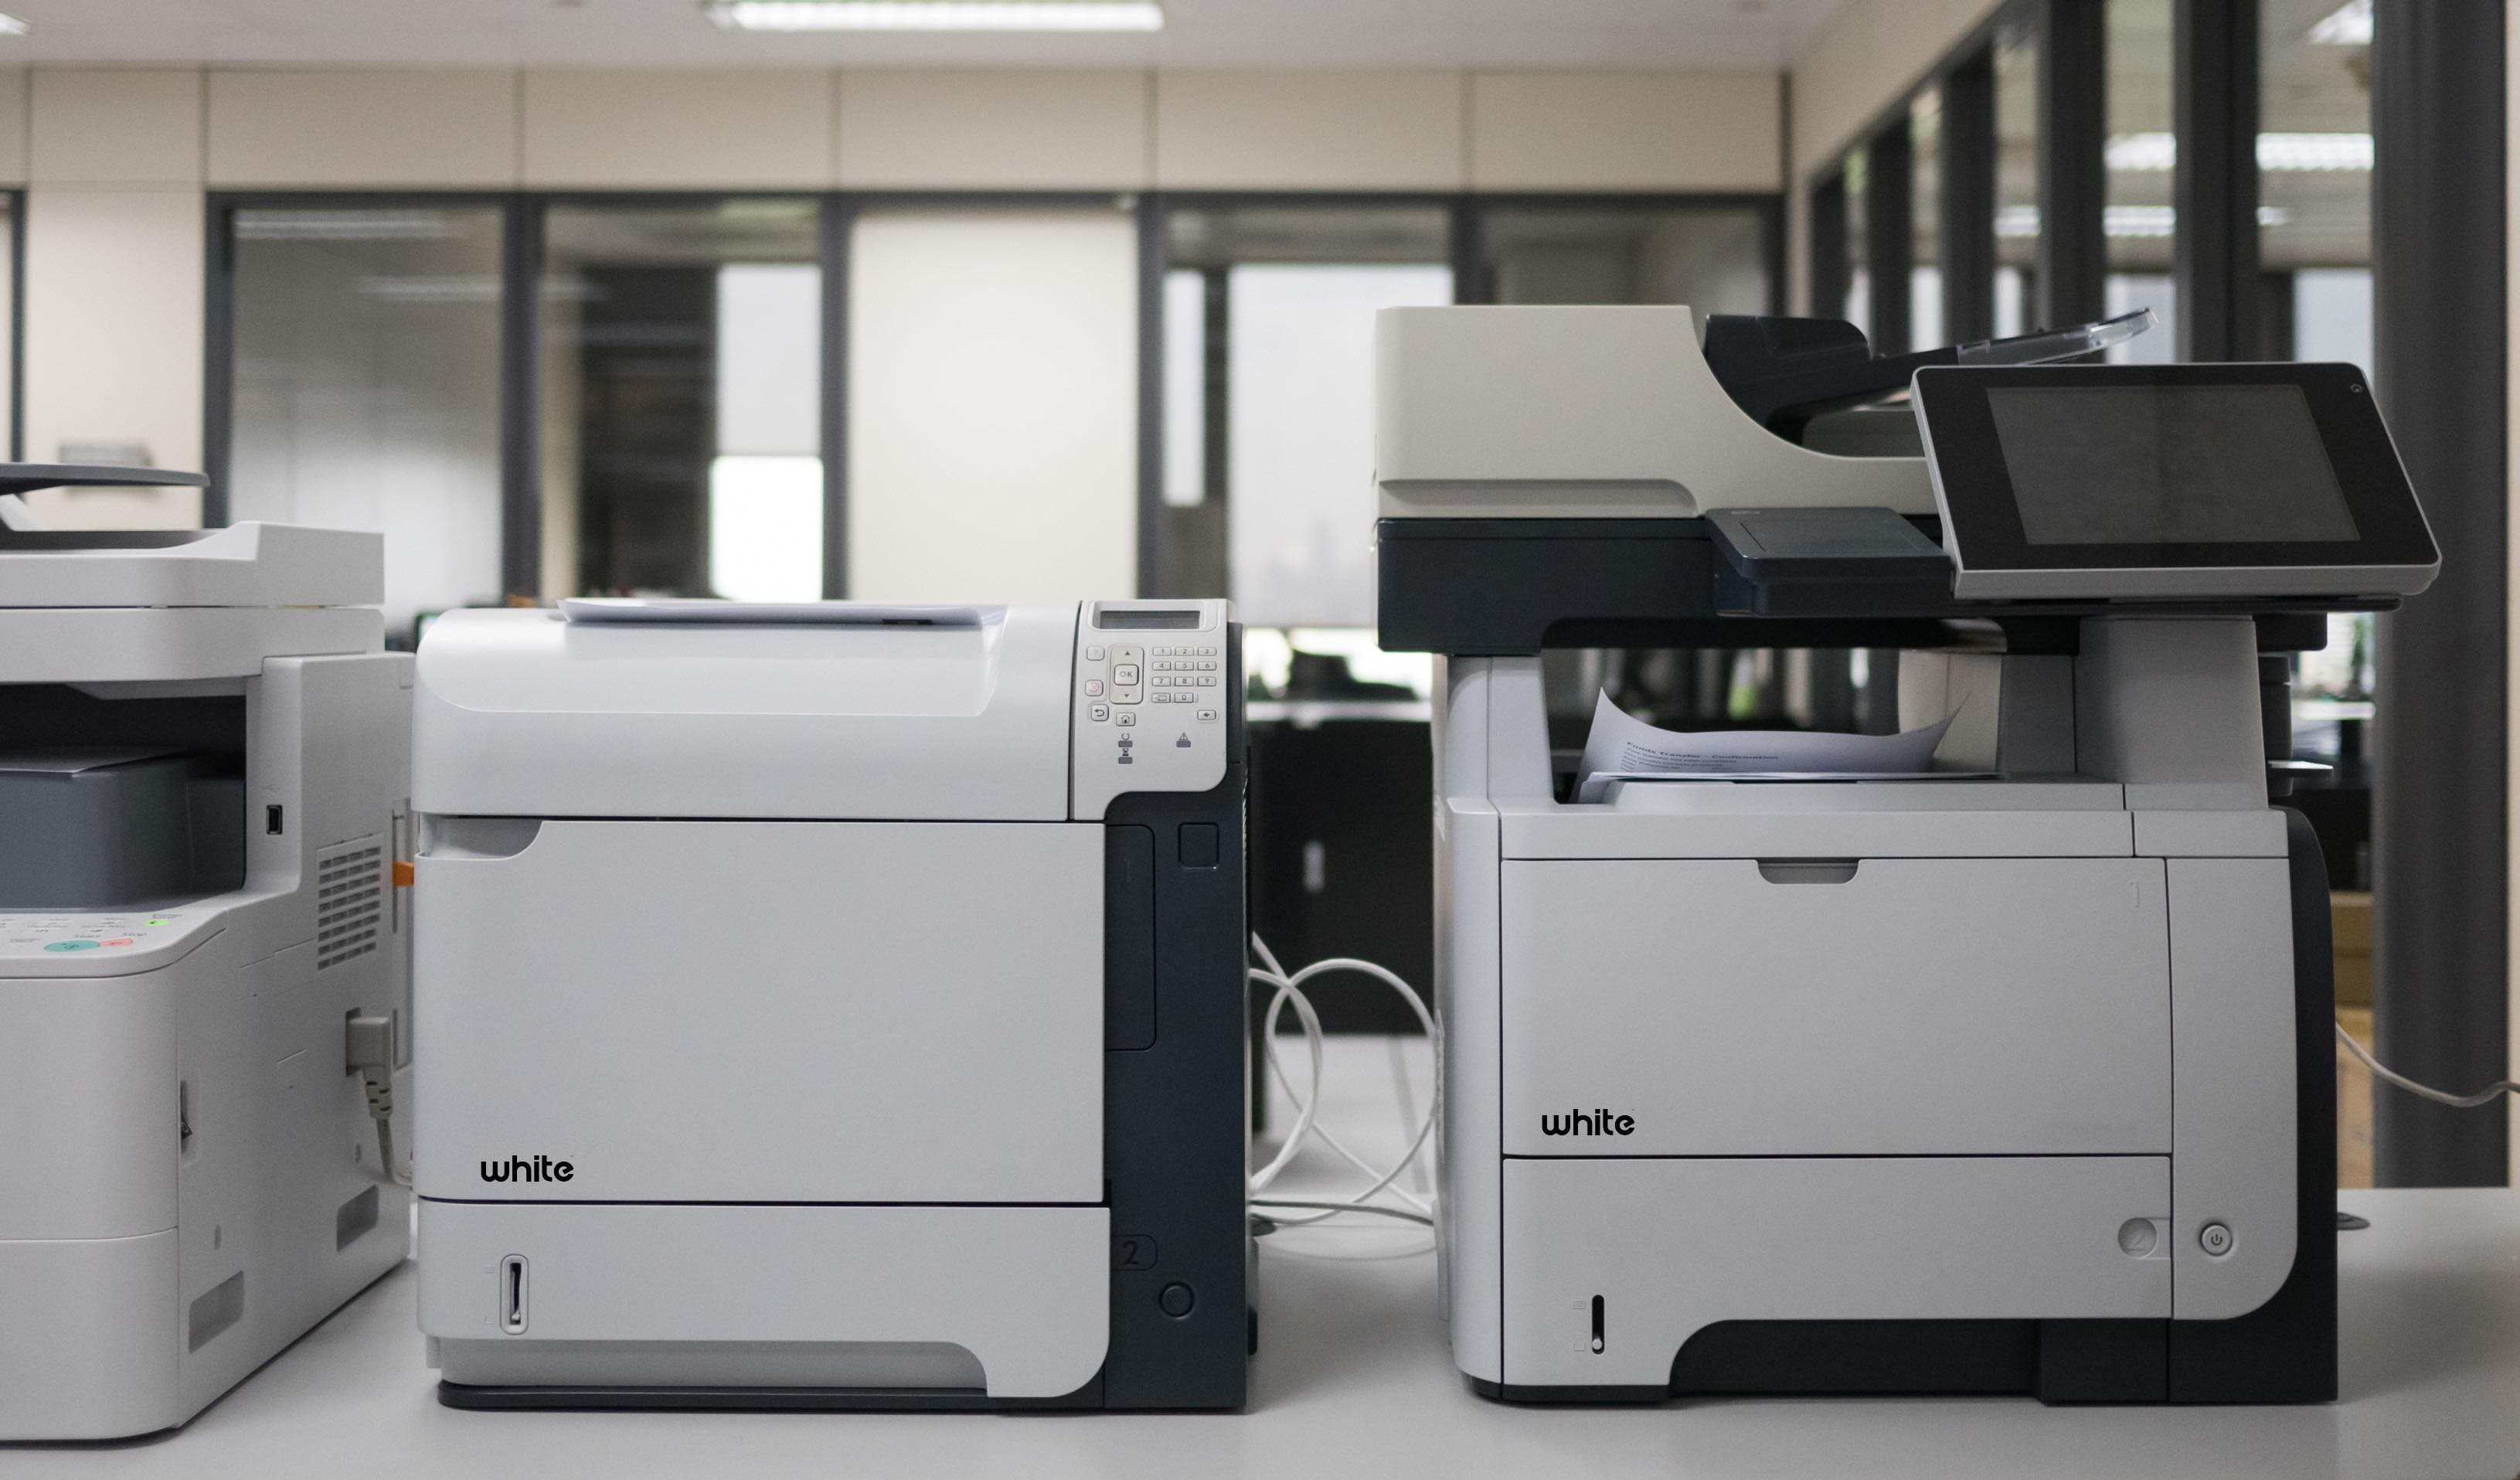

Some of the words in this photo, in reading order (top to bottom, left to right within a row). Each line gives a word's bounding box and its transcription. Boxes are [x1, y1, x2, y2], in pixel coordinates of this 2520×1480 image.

[1542, 1108, 1635, 1136] white
[481, 1155, 574, 1182] white
[1124, 1240, 1140, 1265] 2
